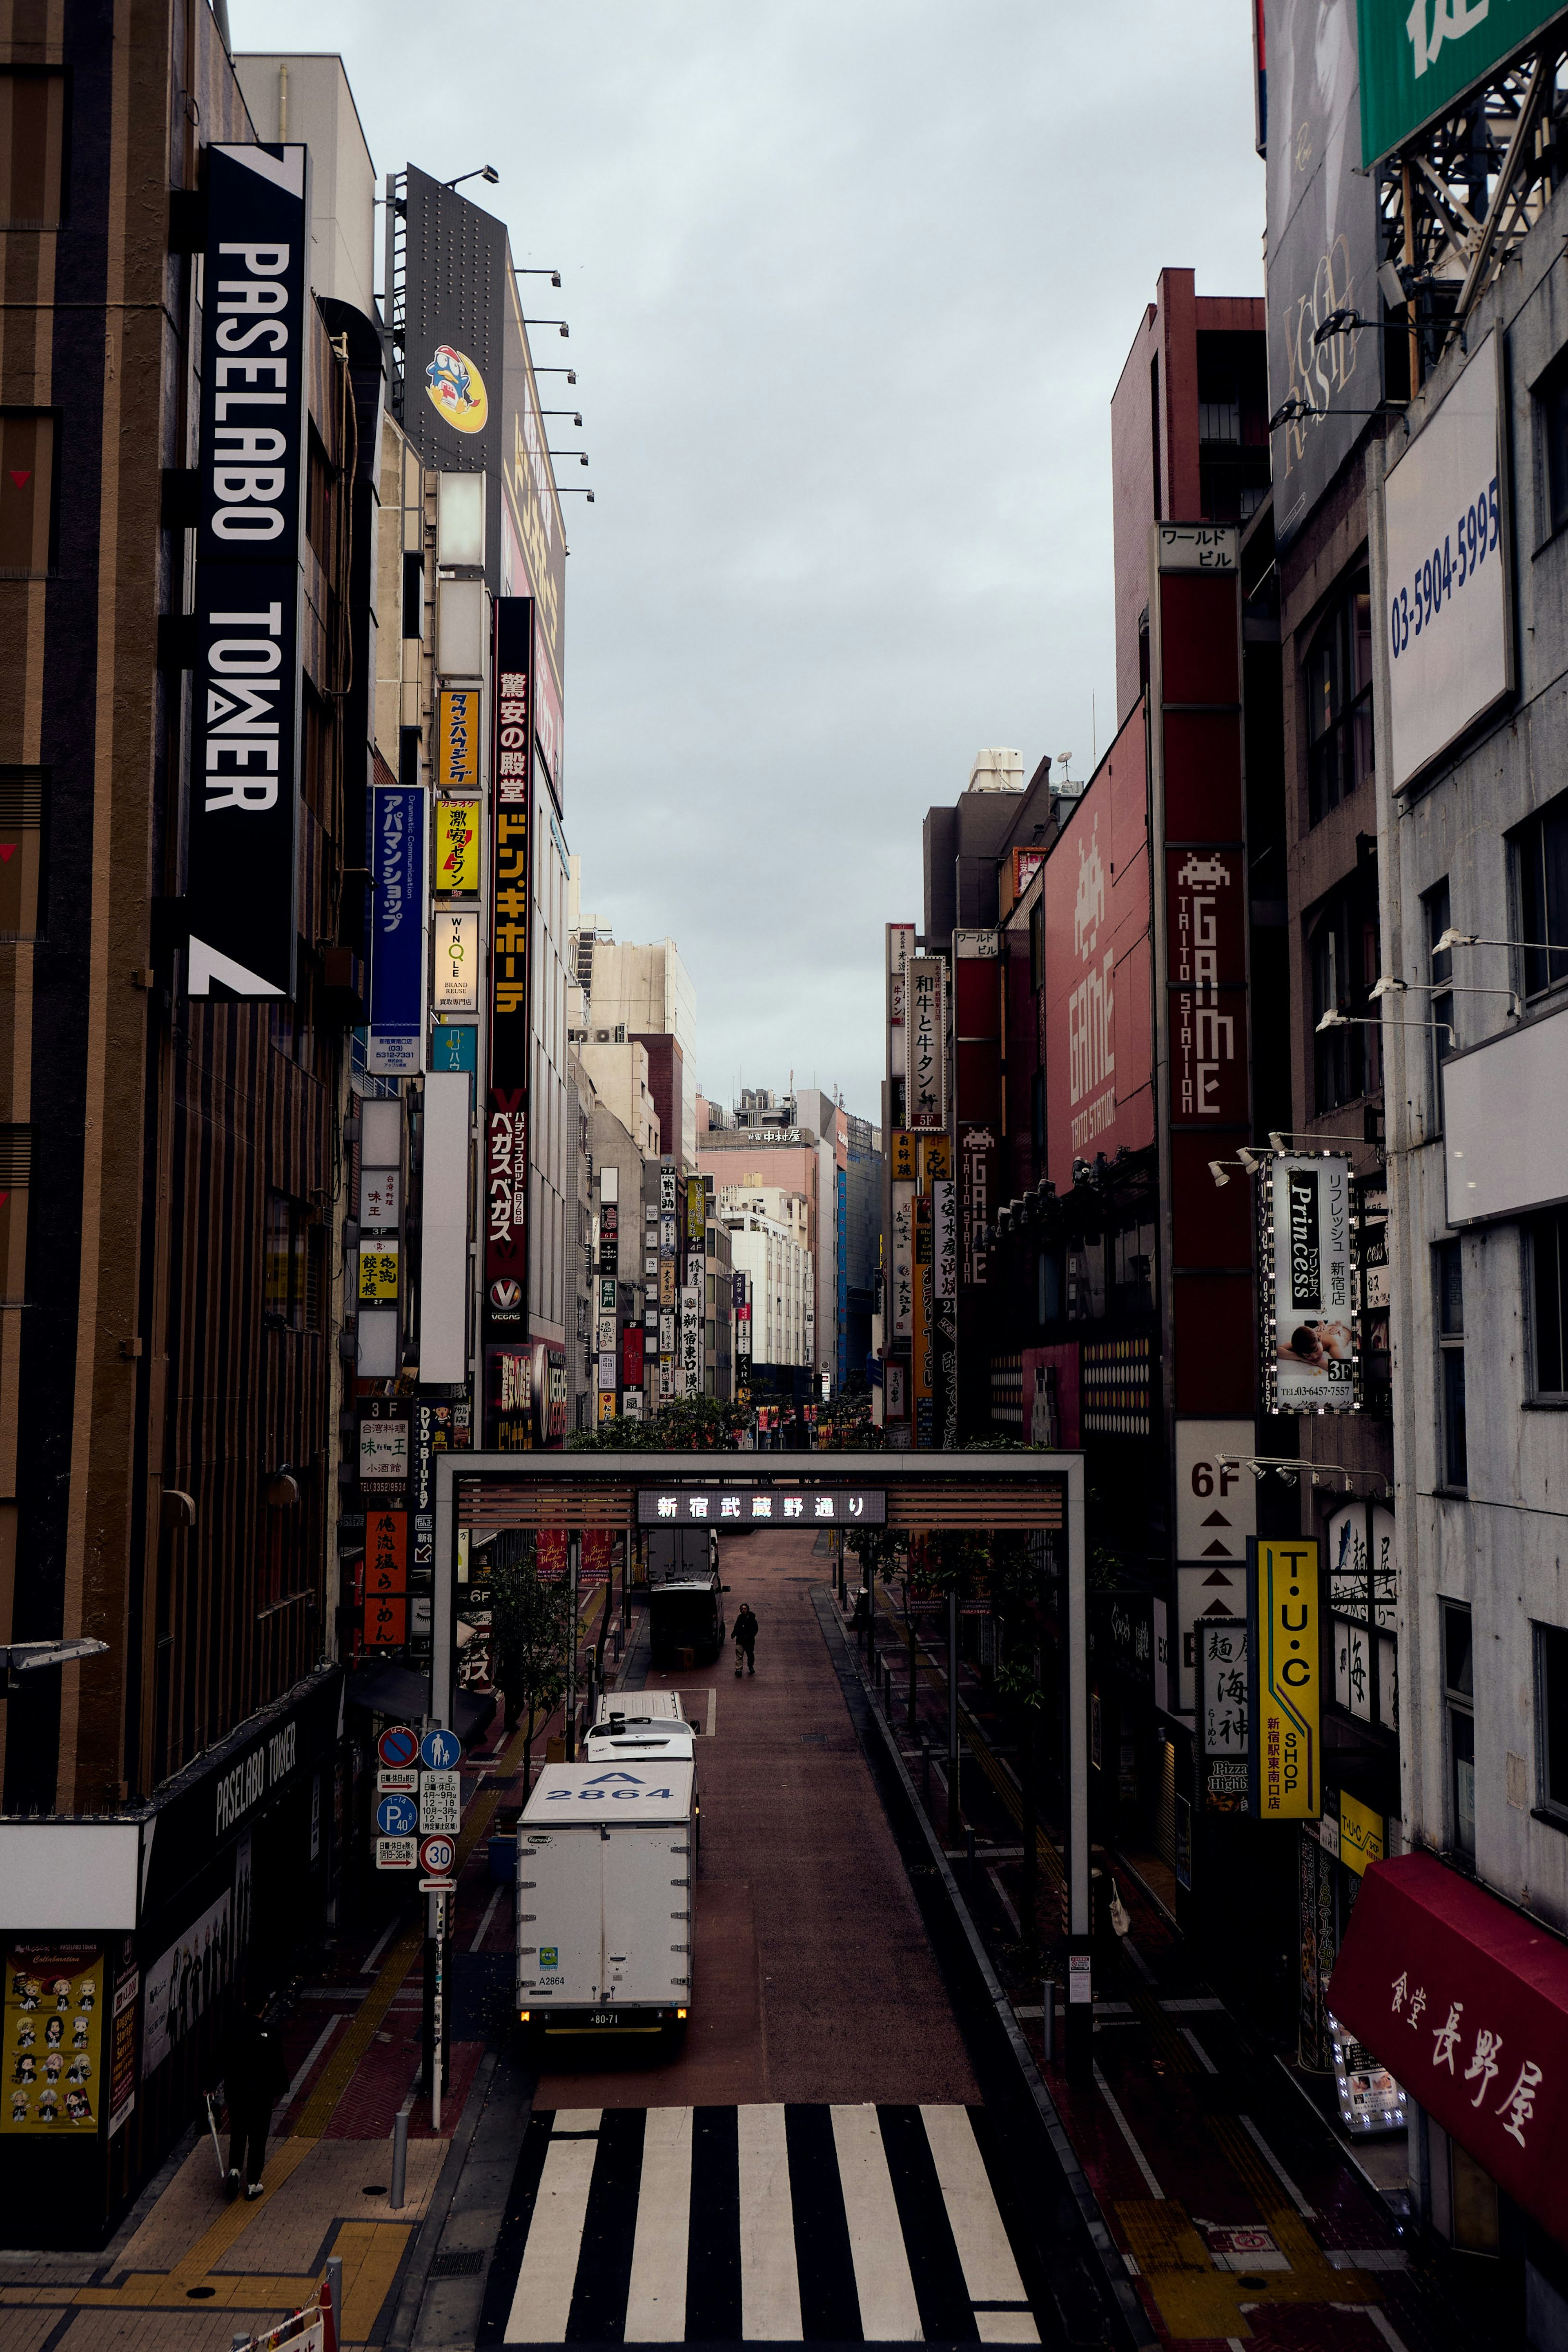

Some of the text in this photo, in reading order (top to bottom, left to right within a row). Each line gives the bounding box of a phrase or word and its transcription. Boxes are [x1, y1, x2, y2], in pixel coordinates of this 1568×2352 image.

[205, 243, 290, 812] PASELABO TOWER
[1162, 530, 1225, 546] ワールド
[1199, 552, 1232, 566] ビル
[1392, 477, 1498, 659] 03-5904-5995
[450, 694, 472, 782] タウンハウジング
[501, 673, 526, 803] 驚安の殿堂
[450, 810, 467, 887] 激安セブン
[382, 795, 403, 932] アパマンショップ
[958, 934, 993, 943] ワールド
[978, 944, 997, 954] ビル
[1178, 896, 1193, 1113] TAITO STATION
[1193, 896, 1234, 1113] GAME
[915, 975, 934, 1088] 和牛と牛タン
[1069, 948, 1115, 1107] GAME
[920, 1115, 933, 1126] 5F
[1071, 1086, 1115, 1152] TAITO STATION
[764, 1130, 801, 1142] 中村屋
[930, 1138, 943, 1146] 4F
[514, 1112, 525, 1190] パチンコ・スロット
[490, 1112, 513, 1241] ベガスベガス
[368, 1191, 381, 1216] 味王
[1292, 1186, 1312, 1298] Princess
[1330, 1175, 1345, 1305] リフレッシュ 新宿店
[1309, 1248, 1319, 1297] プリンセス
[1329, 1360, 1352, 1380] 3F
[1281, 1387, 1349, 1396] TEL:03-6457-7557
[363, 1424, 406, 1433] 台湾料理
[362, 1438, 376, 1457] 味
[392, 1439, 406, 1455] 王
[367, 1463, 401, 1472] 小酒館
[1191, 1462, 1239, 1497] 6F
[360, 1483, 406, 1492] TEL(3352)9534
[657, 1496, 864, 1518] 新宿武蔵野通り
[1207, 1709, 1216, 1746] らーめん
[1215, 1763, 1247, 1775] Pizza
[1267, 1718, 1280, 1809] 新宿駅東南口店
[1285, 1732, 1298, 1794] SHOP
[216, 1746, 264, 1837] PASELABO
[269, 1721, 296, 1787] TOWER
[582, 1772, 646, 1785] A
[545, 1789, 674, 1800] 2864
[387, 1806, 401, 1830] P
[430, 1847, 448, 1864] 30
[1369, 1841, 1379, 1853] SHOP
[33, 1955, 80, 1964] Collaboration
[1392, 1971, 1426, 2029] 食堂
[116, 2006, 134, 2029] Baggage
[596, 2015, 617, 2024] 80-71
[117, 2021, 133, 2044] Storage
[117, 2036, 132, 2060] Service
[1432, 2002, 1542, 2148] 長野屋
